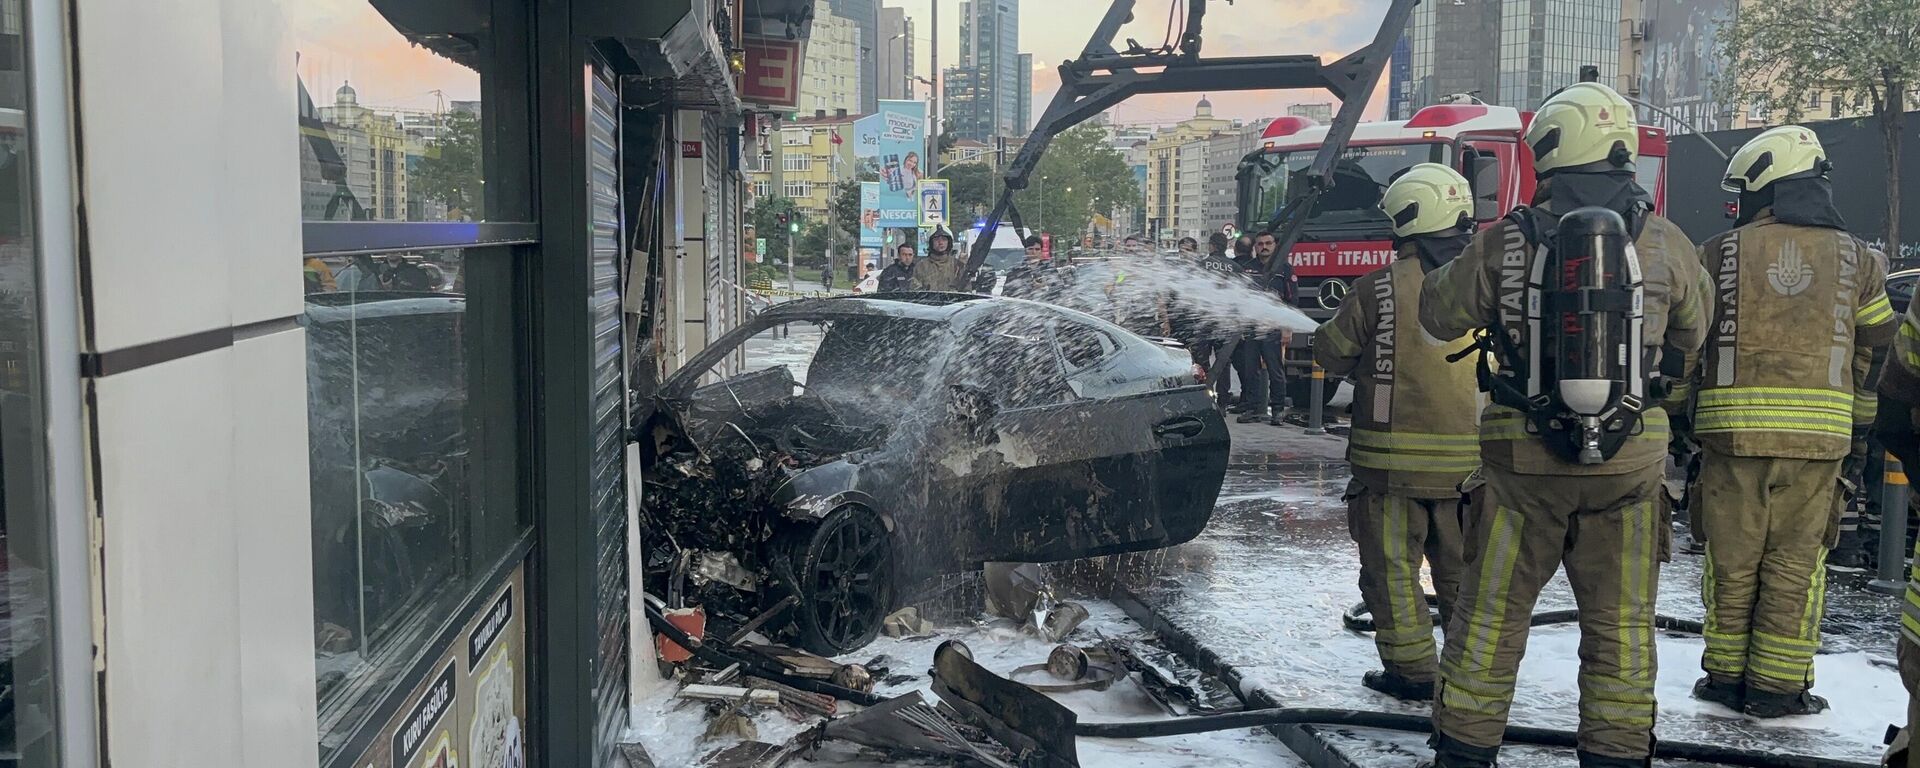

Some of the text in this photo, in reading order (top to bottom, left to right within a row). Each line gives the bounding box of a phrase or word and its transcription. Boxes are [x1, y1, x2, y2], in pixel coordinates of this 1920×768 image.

[682, 144, 696, 152] 104
[880, 208, 918, 221] NESCAF
[403, 713, 422, 757] KURU
